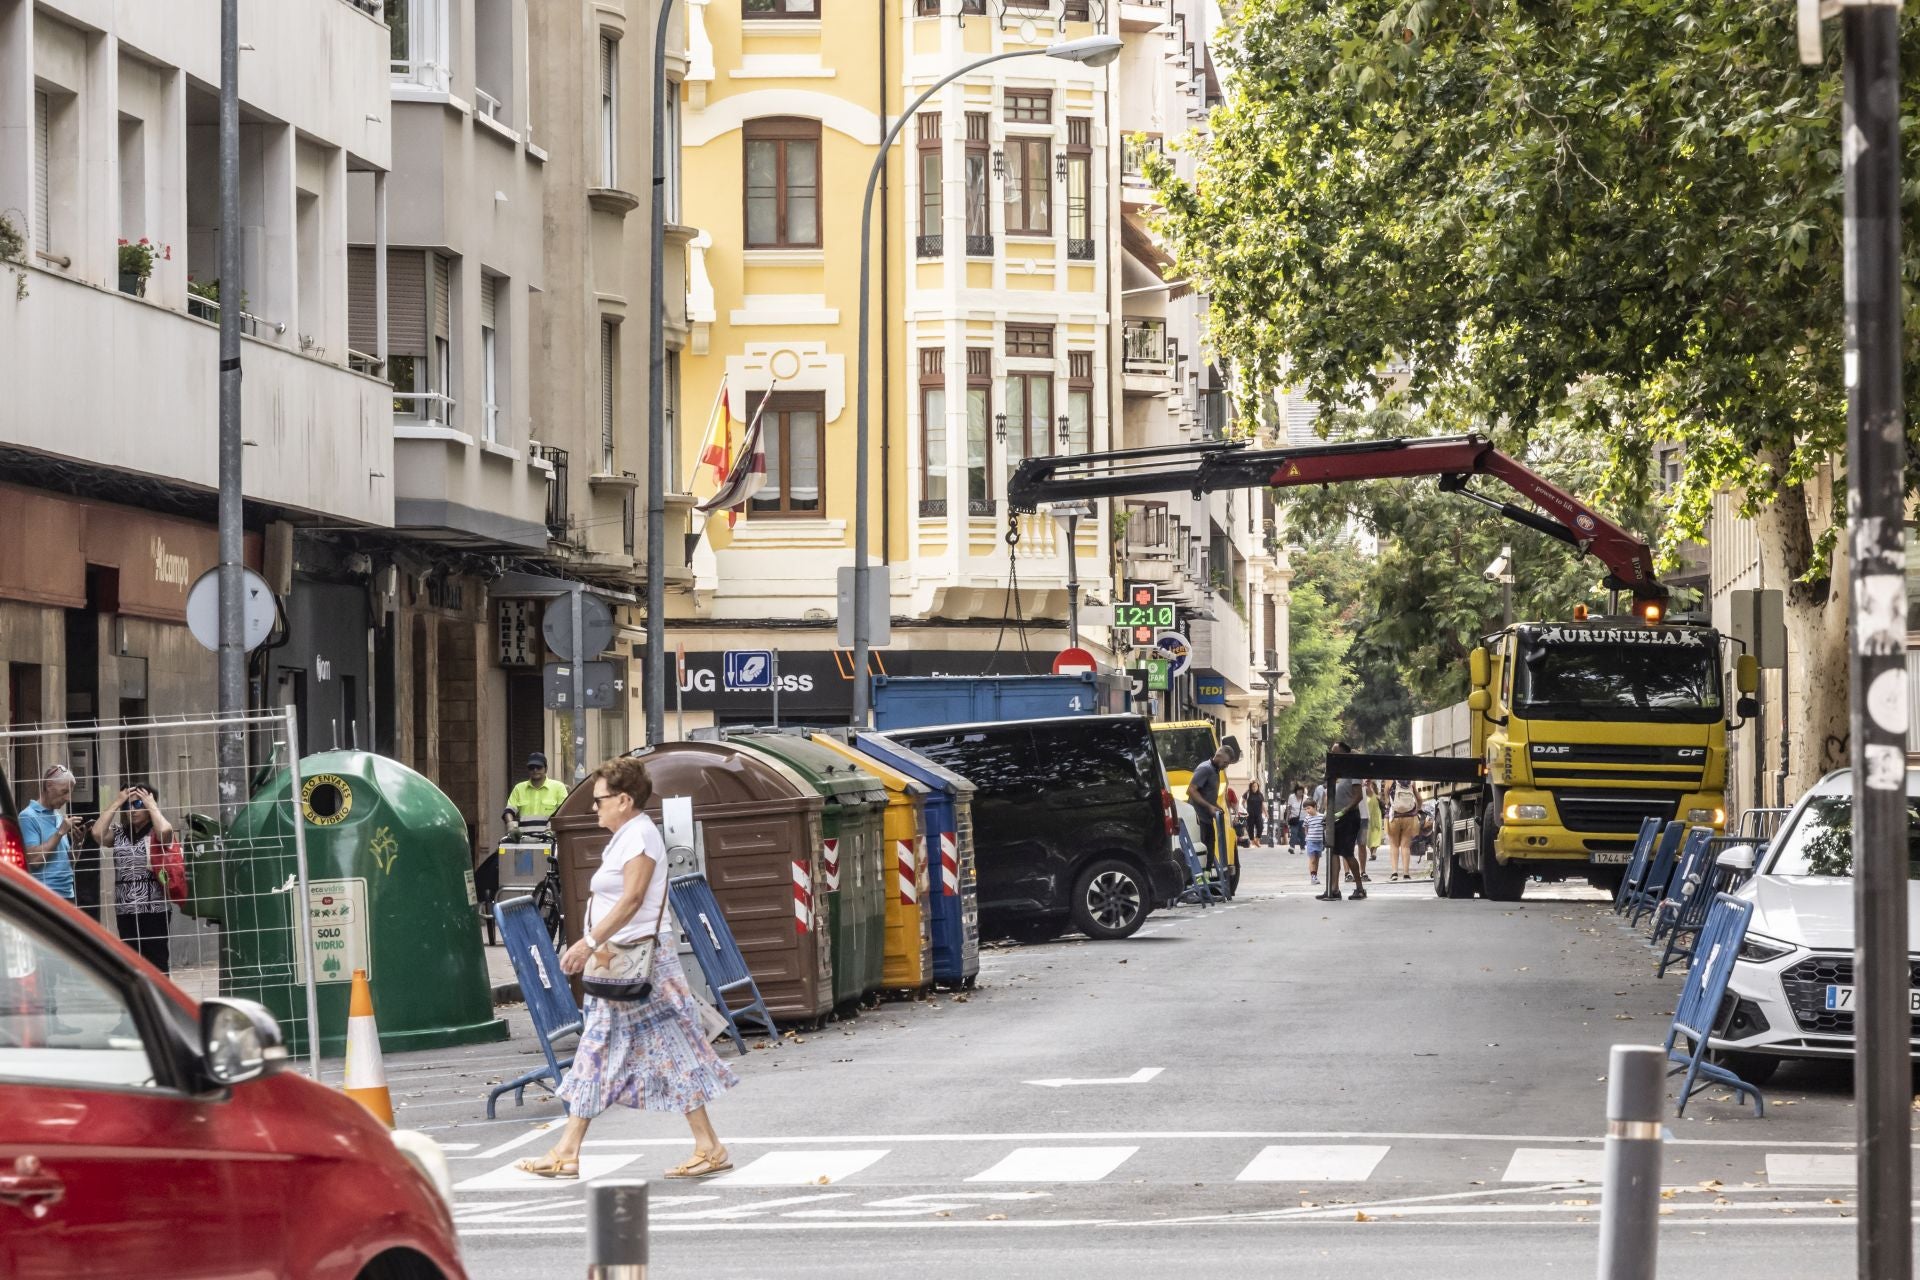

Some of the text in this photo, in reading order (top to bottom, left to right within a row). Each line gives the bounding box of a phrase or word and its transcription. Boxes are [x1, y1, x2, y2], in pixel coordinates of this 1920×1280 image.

[155, 537, 188, 592] Alcampo
[1116, 607, 1172, 625] 12:10
[502, 601, 511, 663] LIBRERIA
[515, 601, 526, 663] FILATELIA
[1562, 628, 1680, 645] URUÑUELA
[1068, 695, 1081, 712] 4
[1532, 745, 1570, 753] DAF
[1677, 749, 1705, 757] CF
[318, 775, 352, 799] ENVASES
[306, 807, 349, 825] DE VIDRIO
[1597, 854, 1619, 863] 1744
[317, 928, 341, 938] SOLO
[315, 940, 345, 950] VIDRIO
